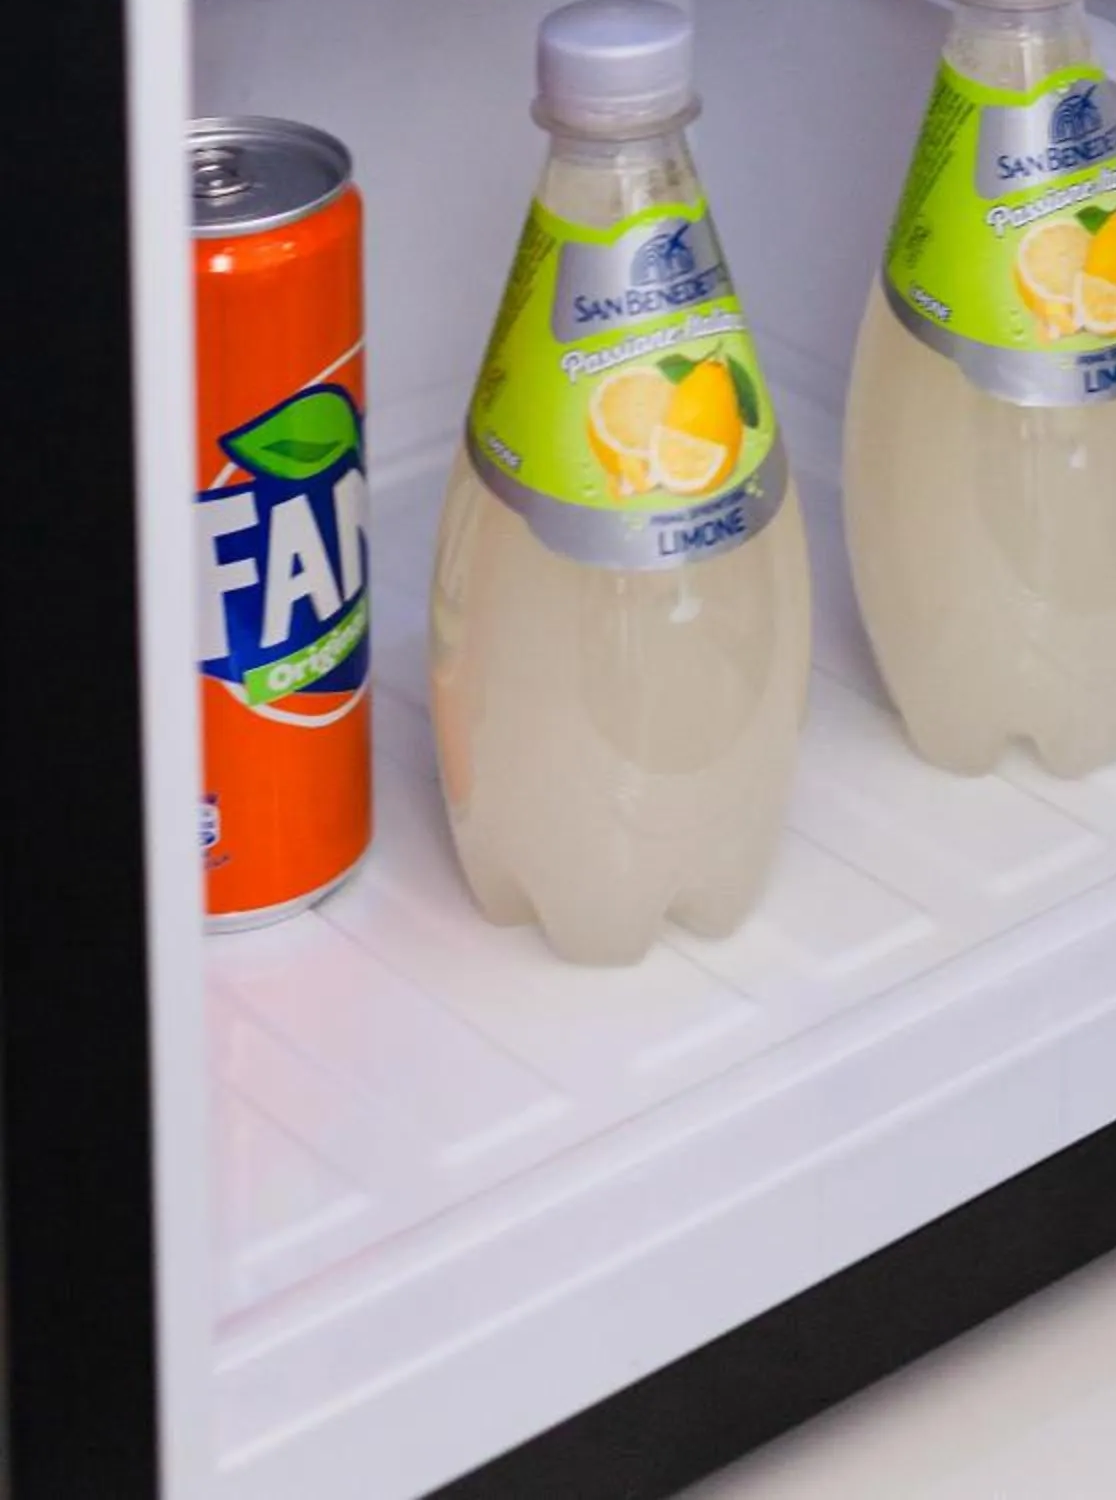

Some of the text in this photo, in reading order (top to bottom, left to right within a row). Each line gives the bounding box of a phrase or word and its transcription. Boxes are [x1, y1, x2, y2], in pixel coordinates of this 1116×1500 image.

[994, 154, 1043, 181] SAN
[572, 294, 623, 324] SAN
[659, 507, 746, 556] LIMONE
